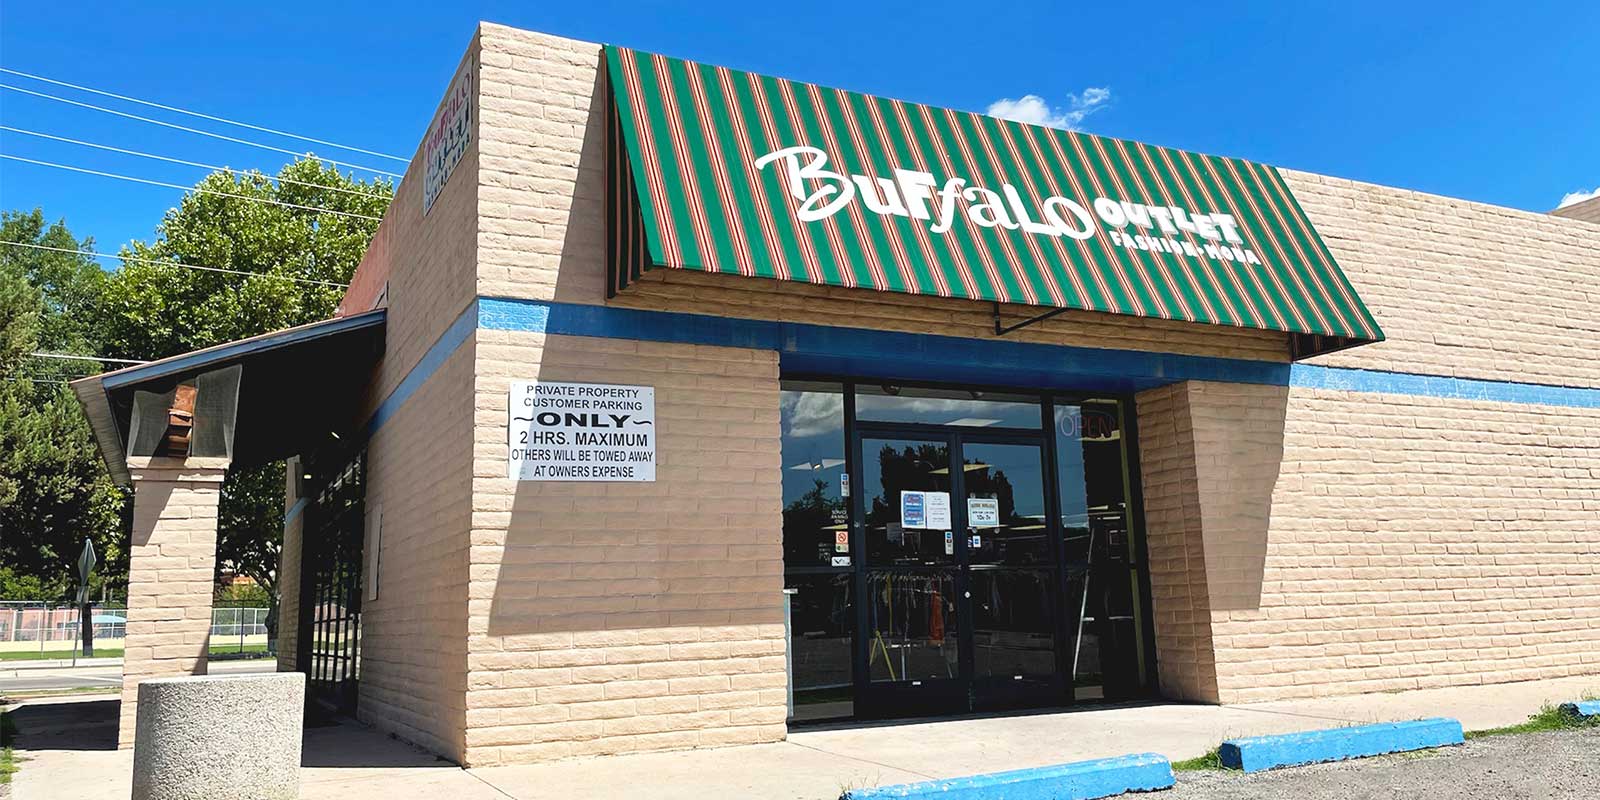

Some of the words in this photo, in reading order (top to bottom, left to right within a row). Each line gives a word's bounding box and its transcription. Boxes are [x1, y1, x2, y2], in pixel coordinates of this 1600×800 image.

[1094, 197, 1243, 244] OUTLET
[527, 385, 575, 396] PRIVATE
[579, 387, 639, 398] PROPERTY
[524, 398, 590, 409] CUSTOMER
[593, 400, 643, 411] PARKING
[520, 431, 528, 444] 2
[533, 431, 570, 445] HRS.
[575, 433, 648, 447] MAXIMUM
[512, 449, 551, 461] OTHERS
[553, 450, 576, 461] WILL
[579, 450, 591, 462] BE
[593, 451, 626, 462] TOWED
[628, 451, 653, 462] AWAY
[534, 466, 546, 477] AT
[548, 466, 590, 477] OWNERS
[592, 466, 634, 478] EXPENSE
